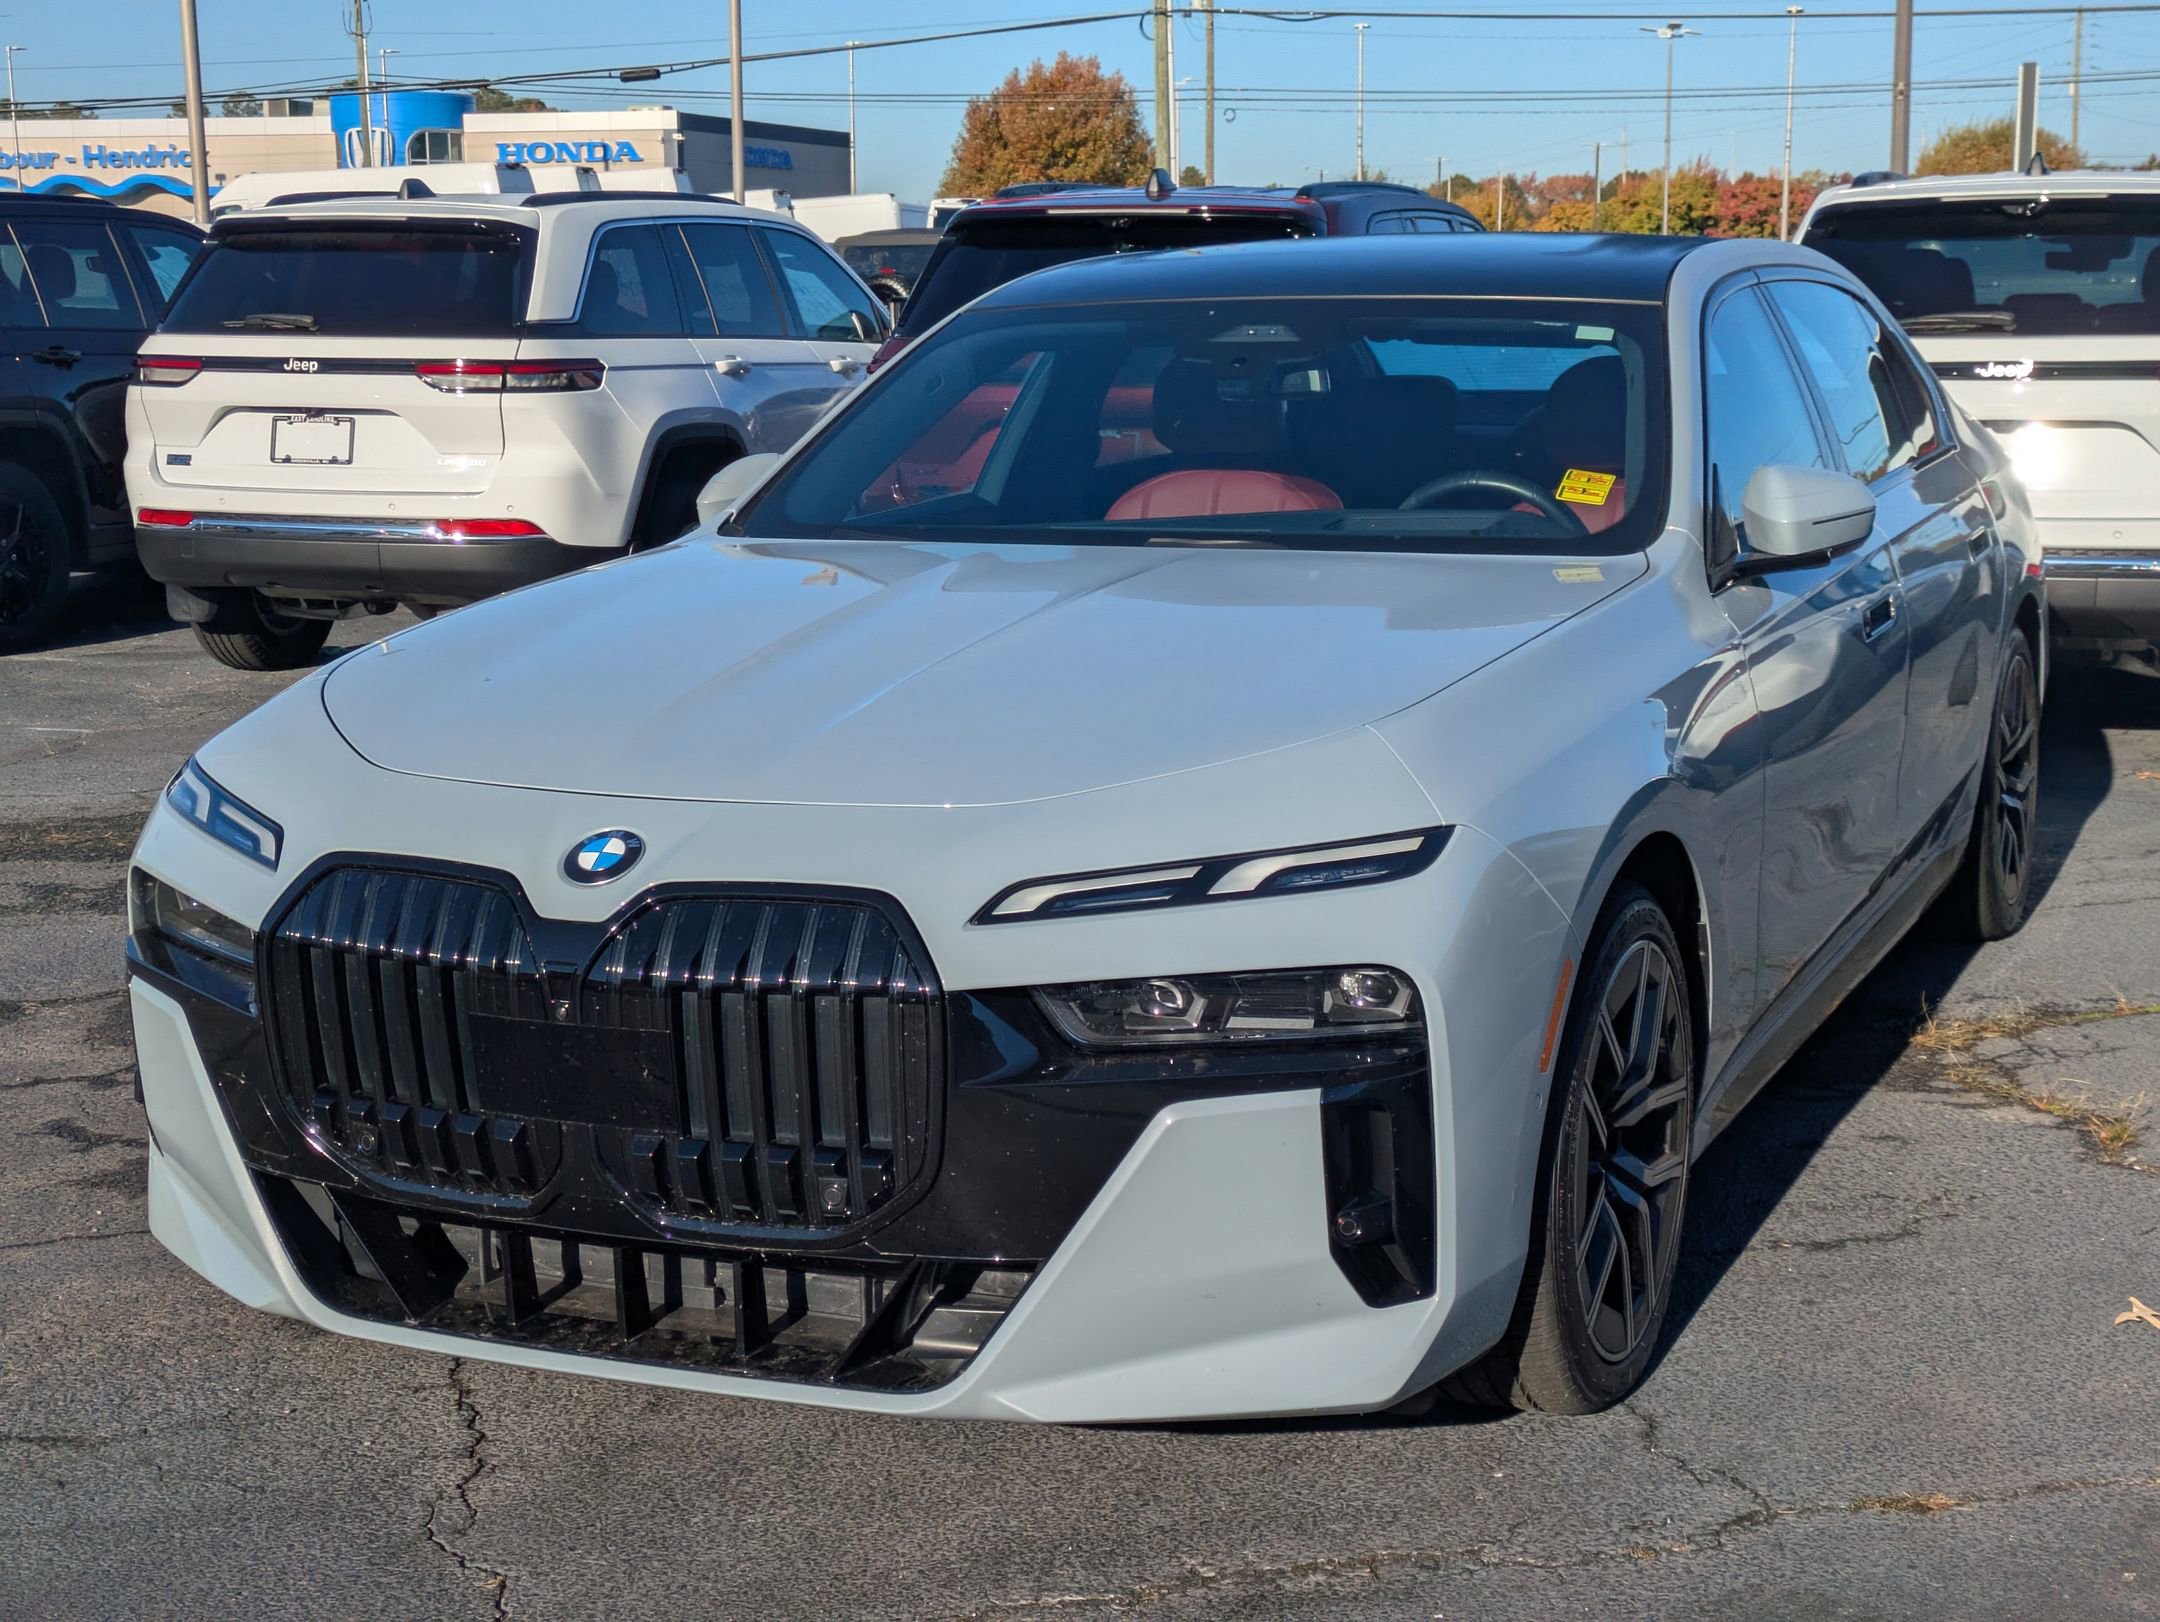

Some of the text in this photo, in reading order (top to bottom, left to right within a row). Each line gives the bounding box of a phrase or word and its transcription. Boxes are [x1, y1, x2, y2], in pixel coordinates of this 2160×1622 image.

[82, 144, 211, 169] Hendric
[495, 141, 643, 164] HONDA
[283, 358, 319, 374] Jeep
